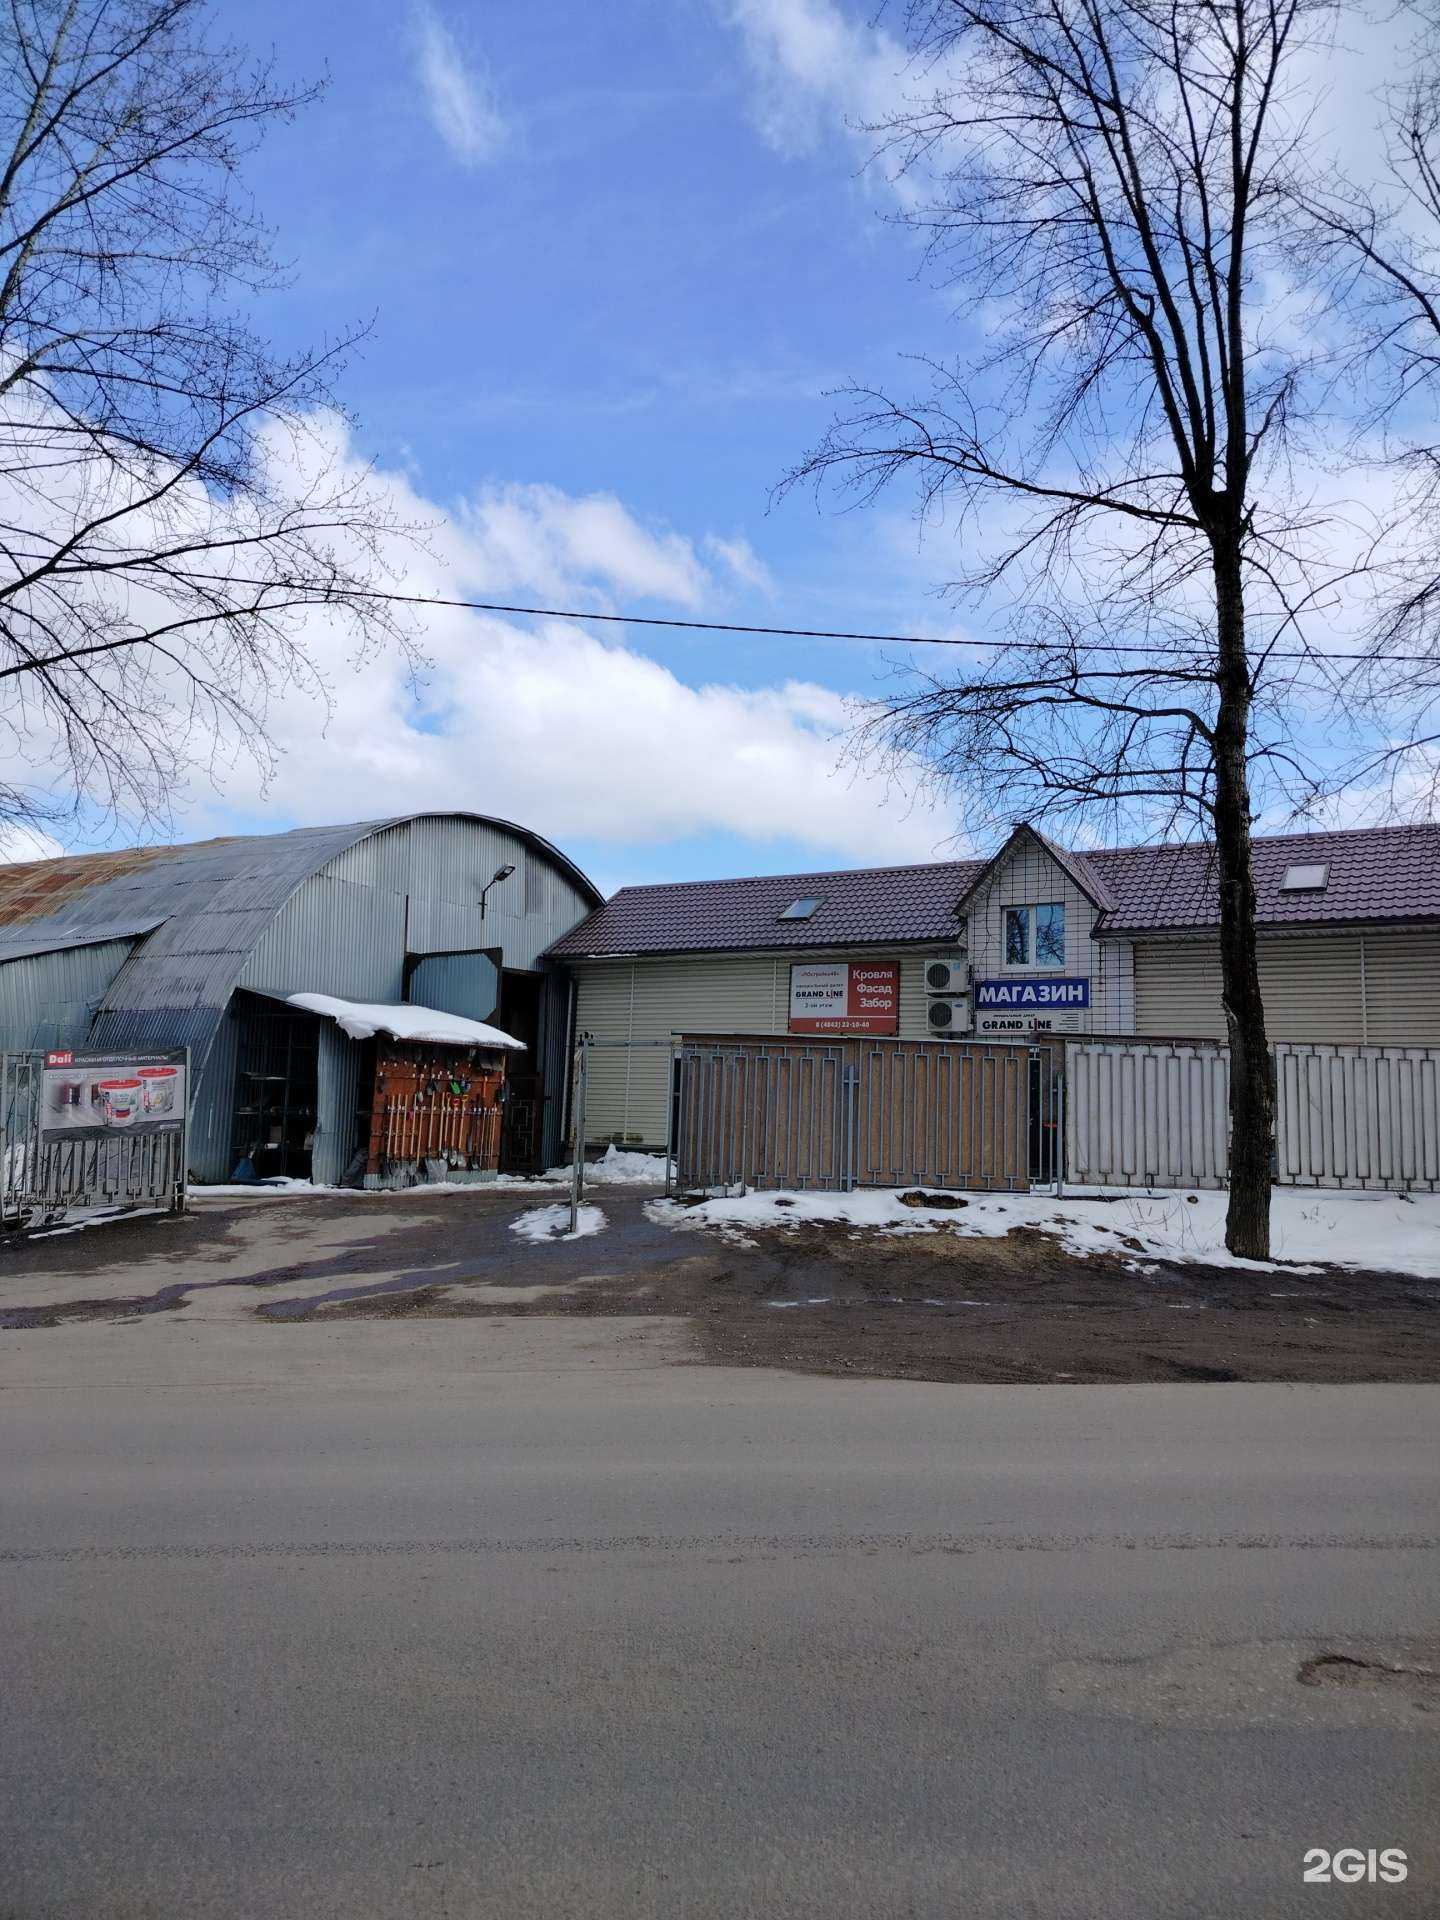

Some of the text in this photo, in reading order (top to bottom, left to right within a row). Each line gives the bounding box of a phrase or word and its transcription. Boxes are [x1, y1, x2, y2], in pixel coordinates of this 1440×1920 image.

[852, 970, 893, 981] Кровля
[795, 990, 824, 998] GRAND
[856, 983, 893, 994] Фасад
[978, 985, 1084, 1003] МАГАЗИН
[859, 997, 892, 1010] Забор
[982, 1020, 1024, 1029] GRAND
[1028, 1018, 1052, 1031] LINE
[49, 1052, 73, 1064] Dali
